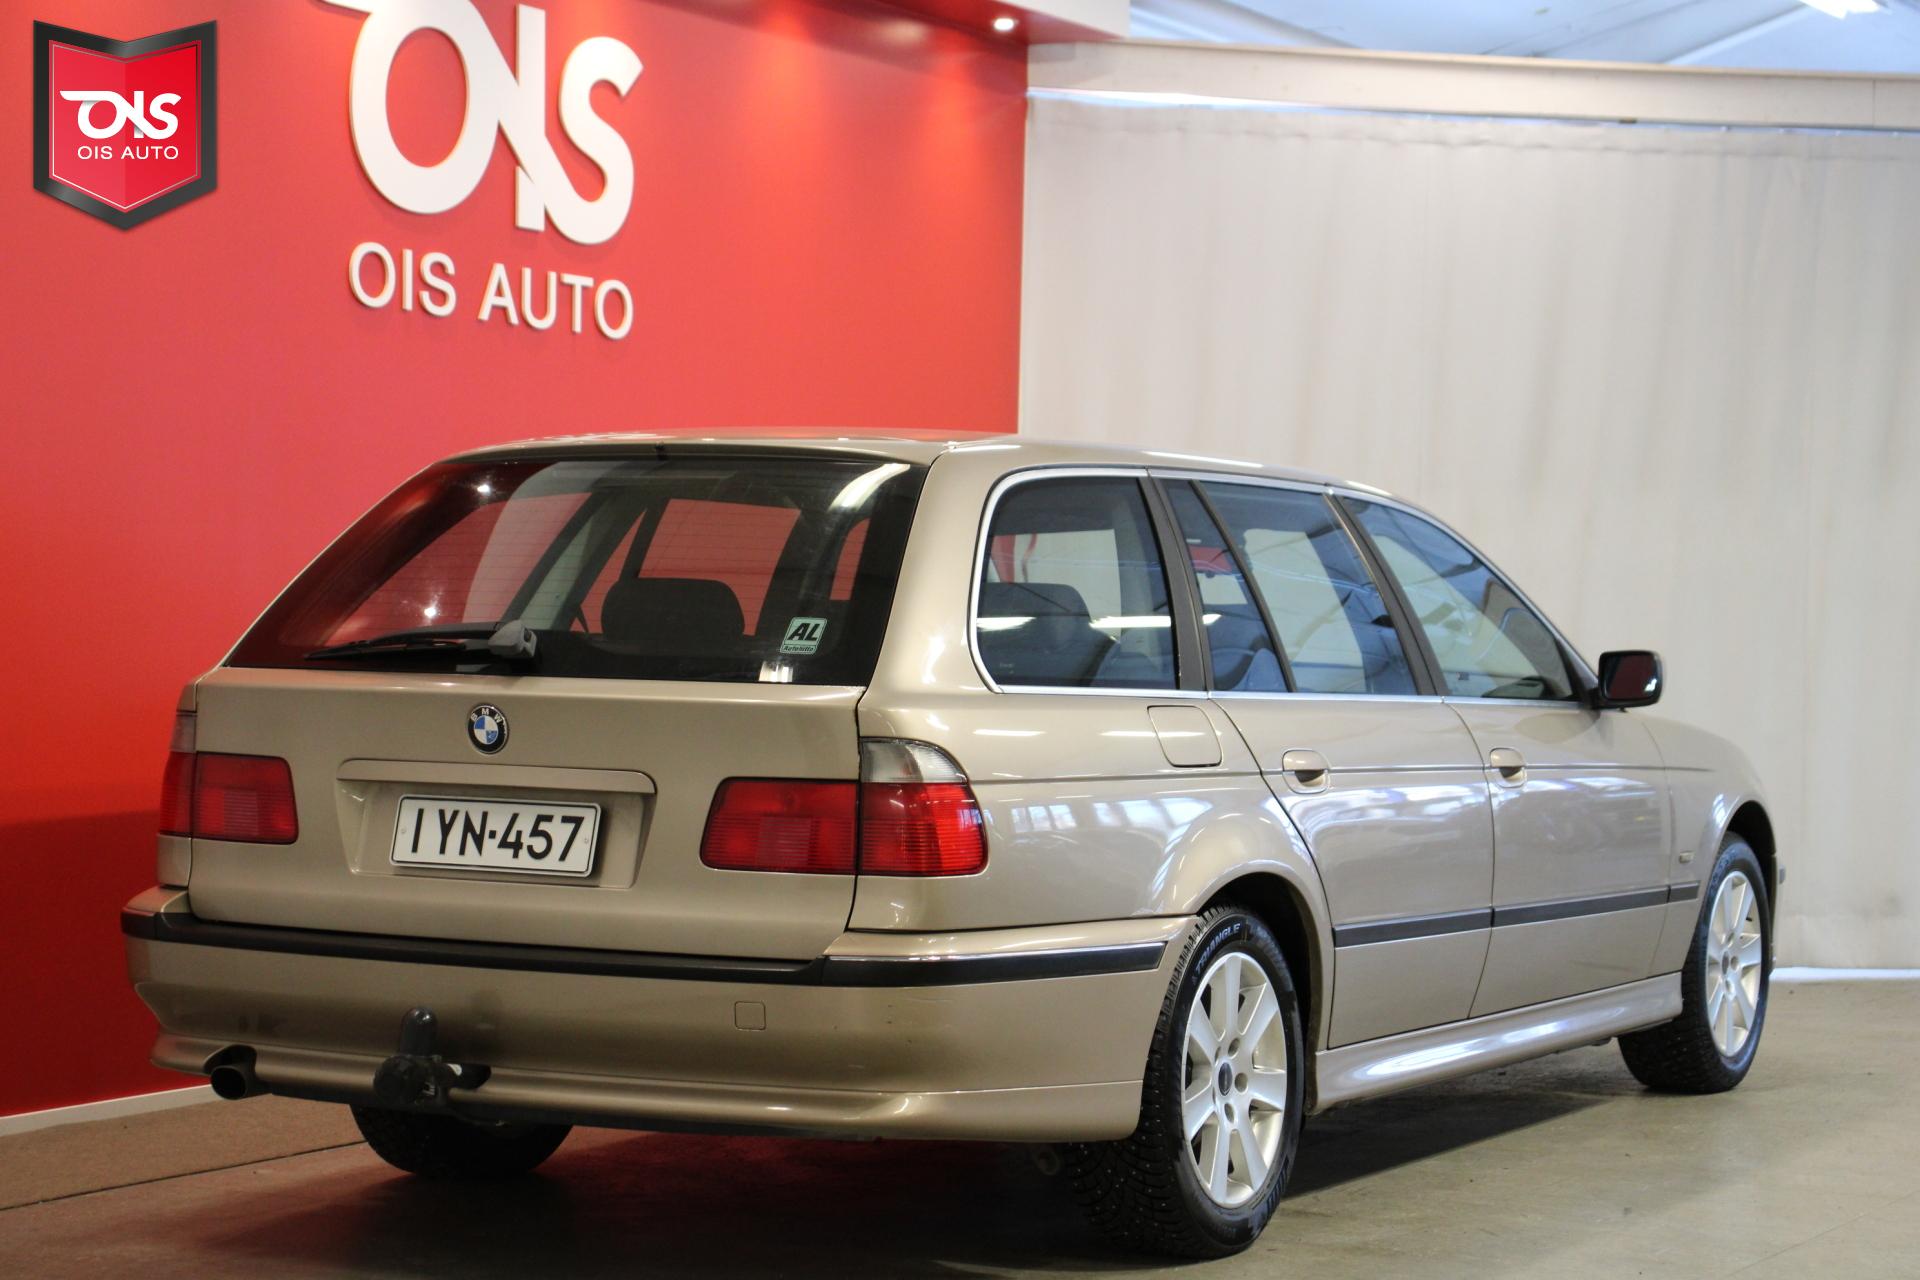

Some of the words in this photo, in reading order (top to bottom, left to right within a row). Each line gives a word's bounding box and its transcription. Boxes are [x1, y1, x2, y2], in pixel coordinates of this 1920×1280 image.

[319, 0, 644, 245] OIS
[349, 241, 457, 317] OIS
[477, 262, 634, 340] AUTO
[787, 622, 820, 641] AL
[470, 707, 503, 723] BMW
[411, 807, 585, 862] IYN-457
[1195, 923, 1241, 974] TRIANGLE
